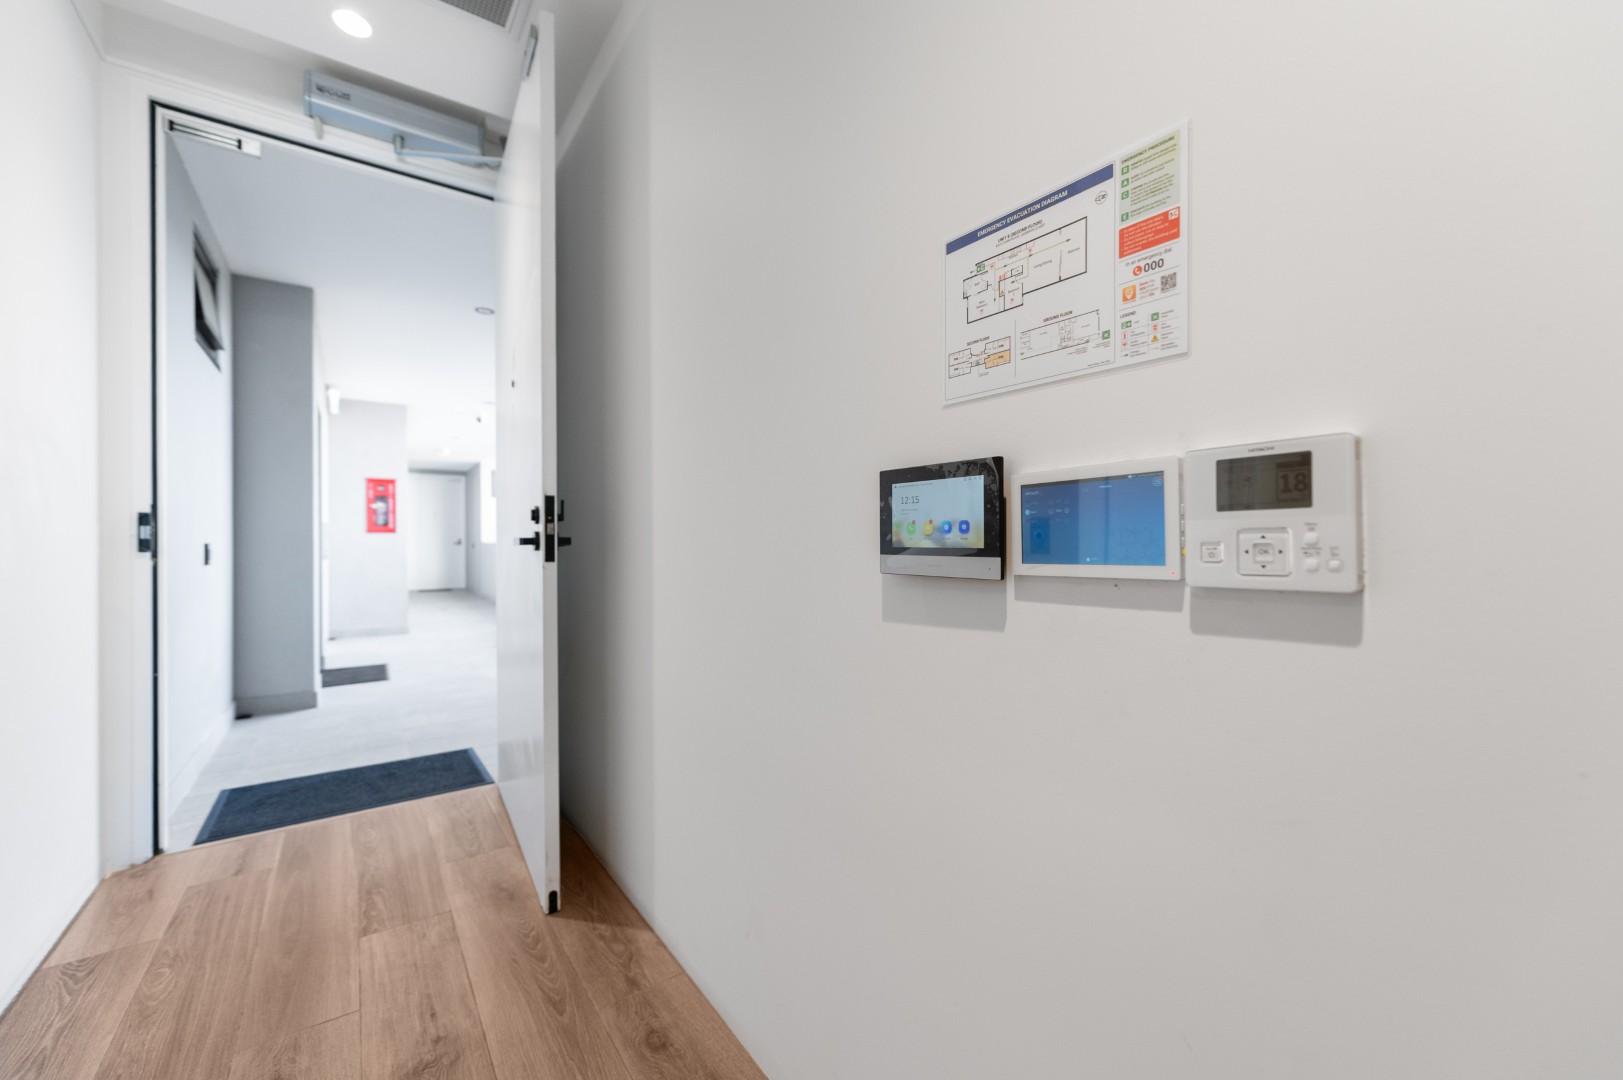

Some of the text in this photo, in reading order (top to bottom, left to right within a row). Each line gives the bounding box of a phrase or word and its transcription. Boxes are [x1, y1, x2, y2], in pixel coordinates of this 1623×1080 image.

[977, 218, 1006, 237] EMERGENCY
[1006, 203, 1041, 224] EVACUATION
[1041, 190, 1068, 207] DIAGRAM
[1143, 258, 1164, 273] 000
[1043, 310, 1073, 323] GROUND FLOOR
[1120, 310, 1136, 319] LEGEND
[1280, 472, 1307, 494] 18
[900, 495, 920, 505] 12:15
